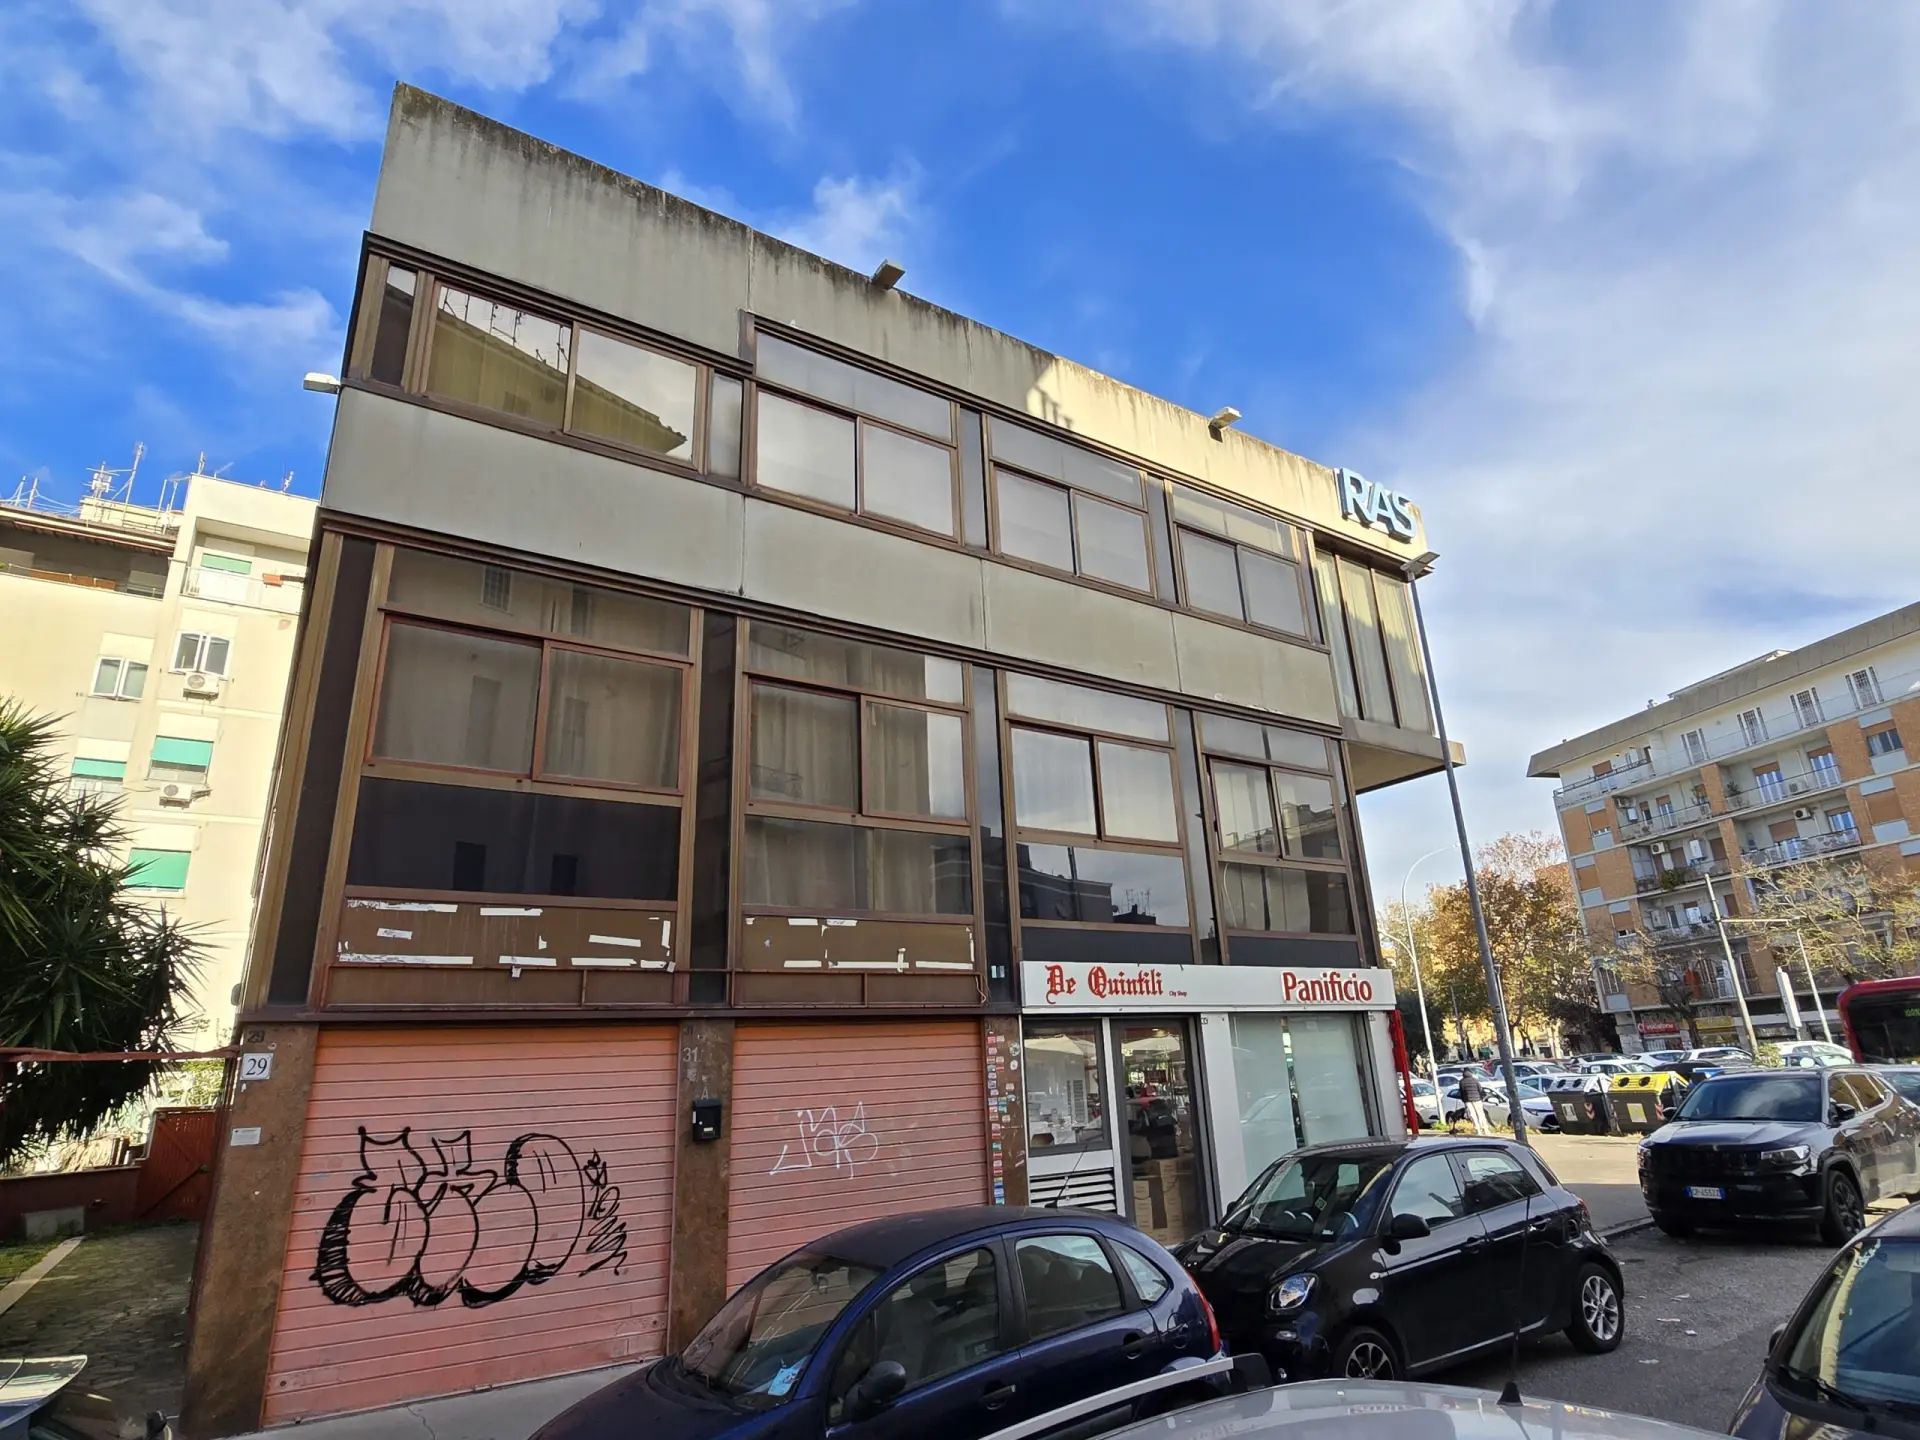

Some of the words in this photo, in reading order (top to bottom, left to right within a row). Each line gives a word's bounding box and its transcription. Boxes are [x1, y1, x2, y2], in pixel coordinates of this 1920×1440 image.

[1340, 467, 1417, 540] RAS
[1045, 964, 1076, 1004] De
[1088, 966, 1164, 999] Quintili
[1282, 971, 1373, 1002] Panificio
[245, 1057, 268, 1076] 29
